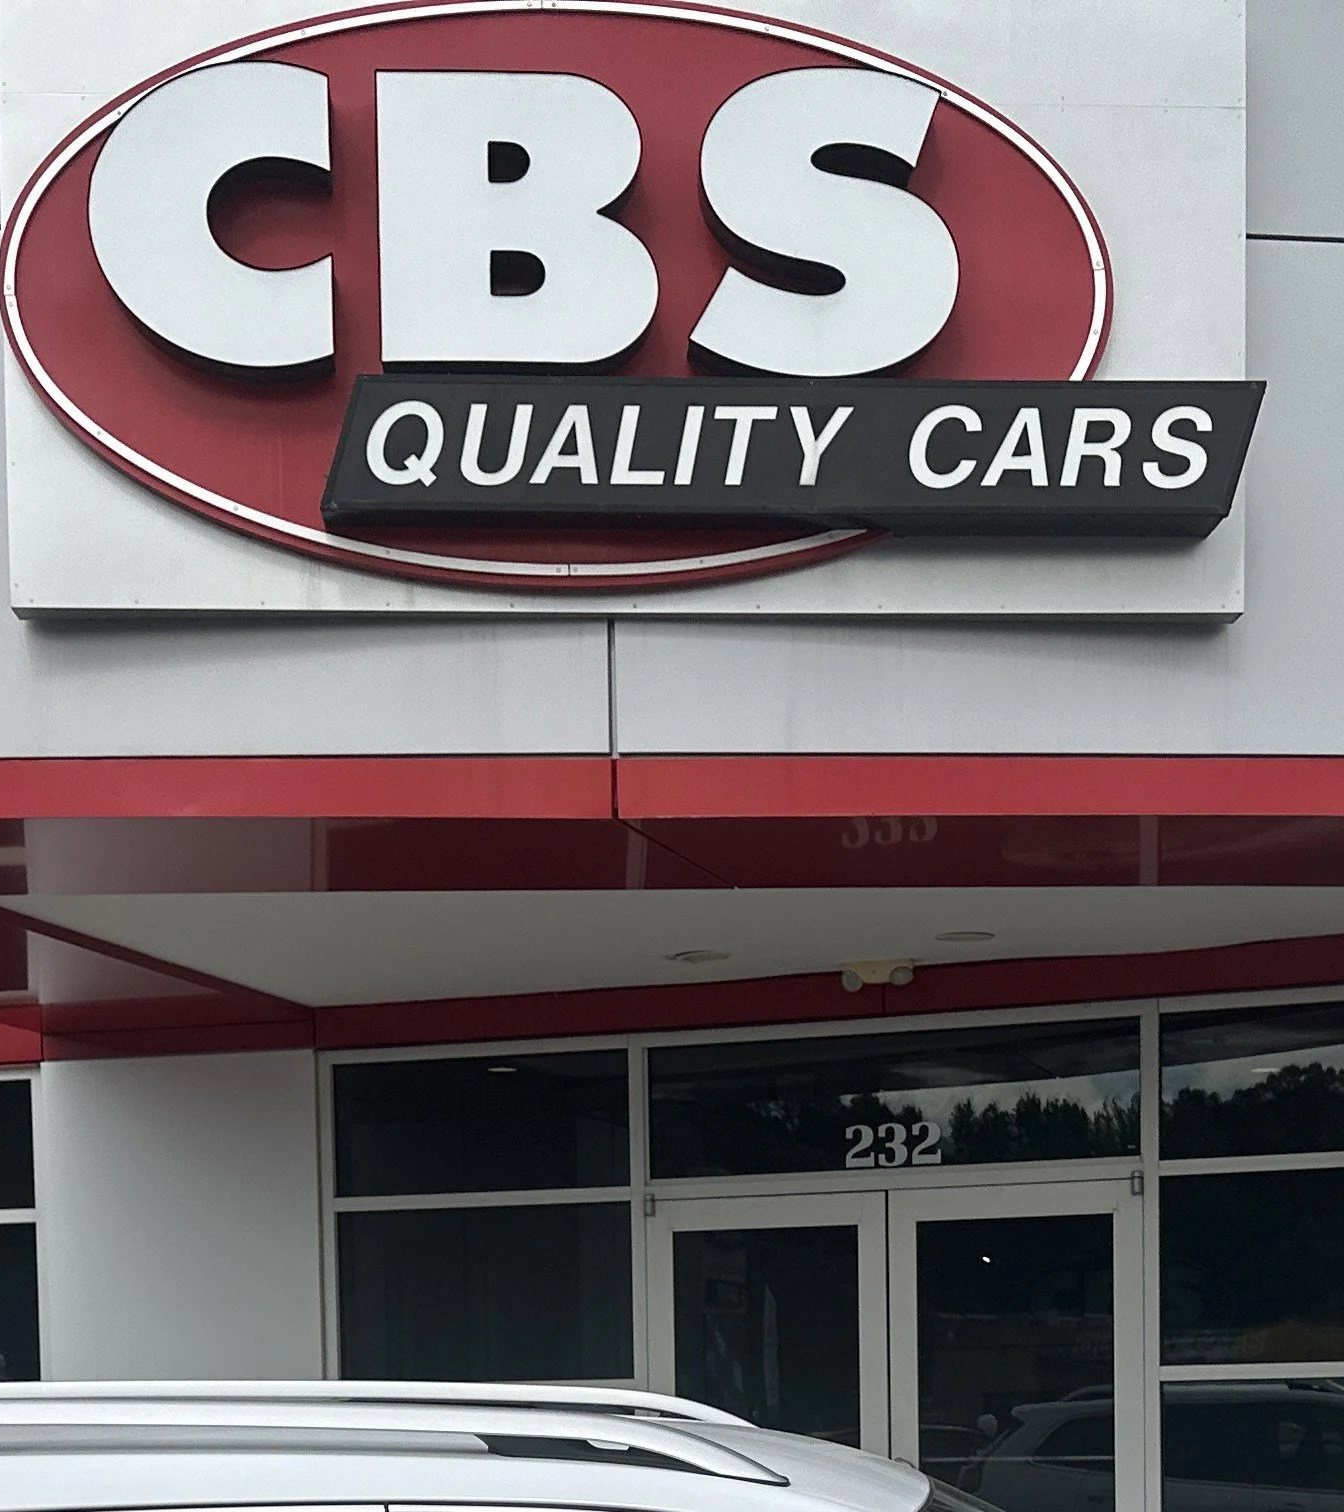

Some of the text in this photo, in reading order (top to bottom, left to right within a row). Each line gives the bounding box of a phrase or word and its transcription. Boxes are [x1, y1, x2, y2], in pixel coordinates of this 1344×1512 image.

[87, 60, 960, 379] CBS
[365, 400, 1215, 491] QUALITY CARS
[844, 1121, 943, 1169] 232
